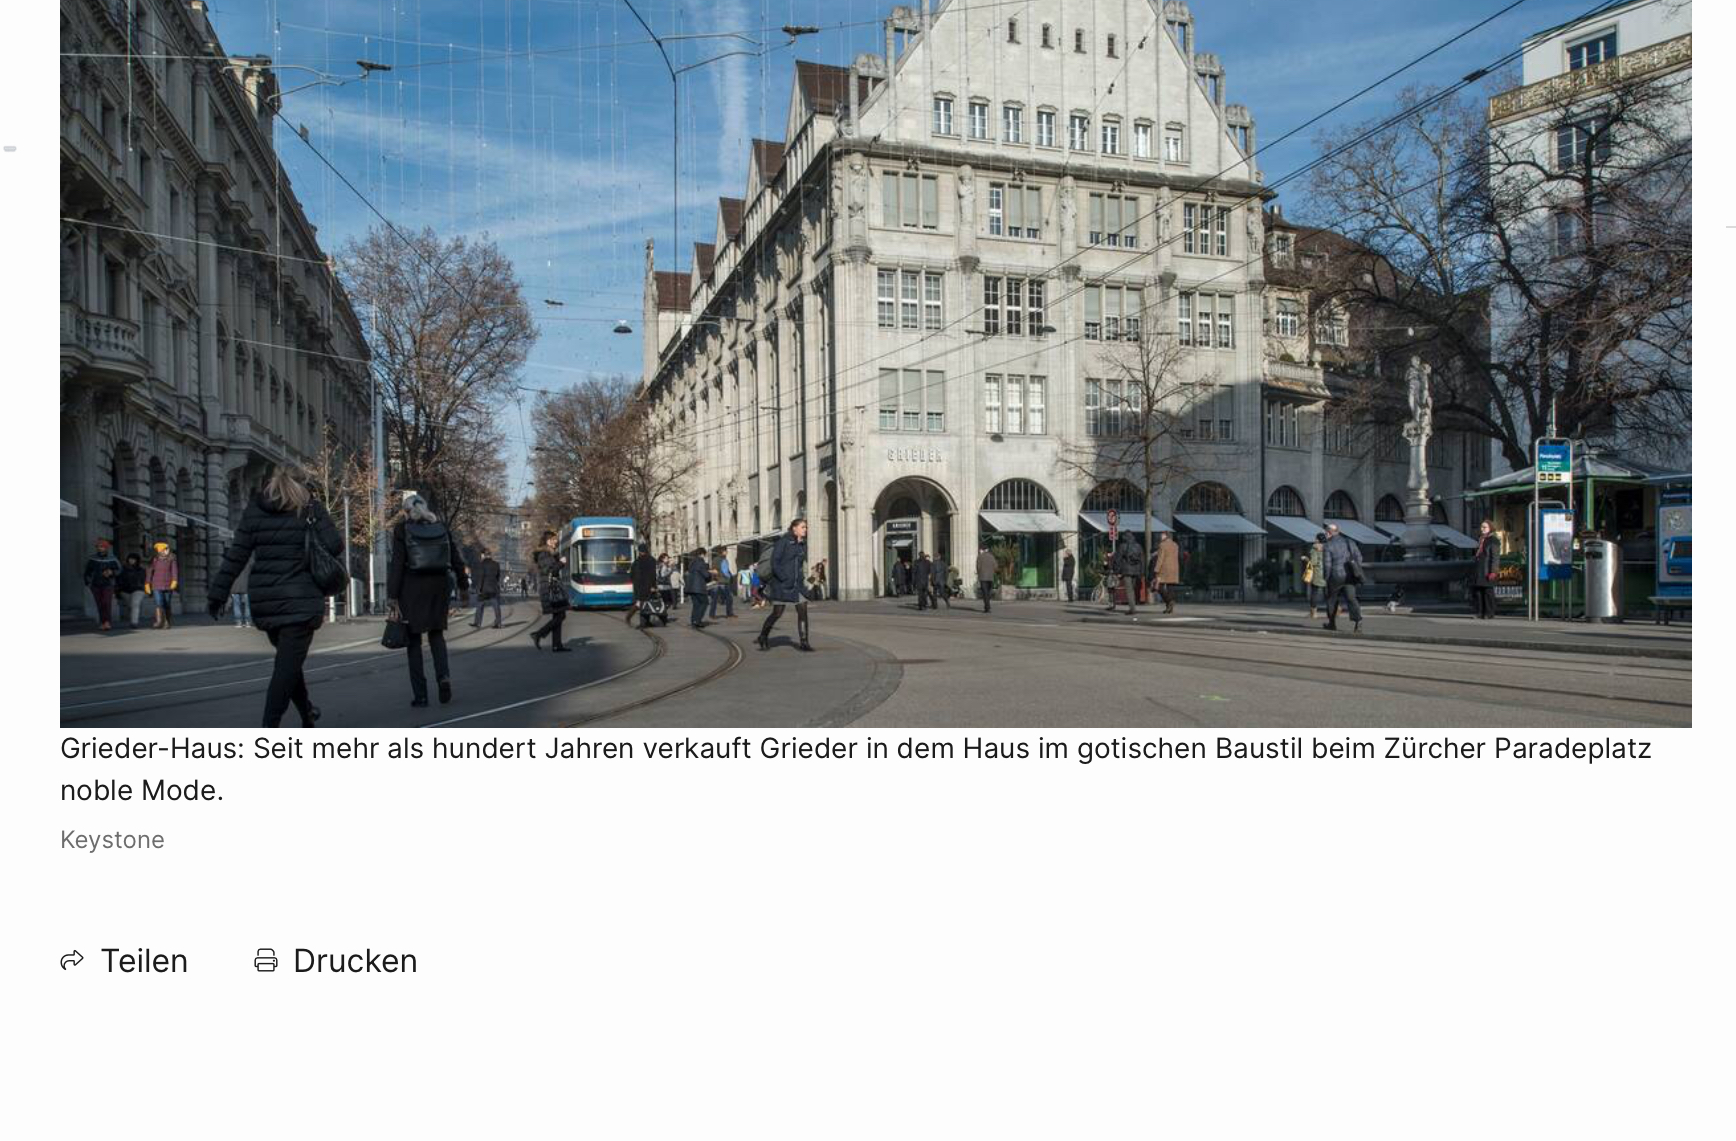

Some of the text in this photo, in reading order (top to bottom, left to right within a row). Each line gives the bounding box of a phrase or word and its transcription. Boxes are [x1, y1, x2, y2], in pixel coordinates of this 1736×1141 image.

[62, 737, 1651, 764] Grieder-Haus: Seit mehr als hundert Jahren verkauft Grieder in dem Haus im gotischen Baustil beim Zürcher Paradeplatz
[62, 779, 222, 801] noble Mode.
[62, 830, 164, 853] Keystone
[101, 948, 186, 973] Teilen
[296, 949, 416, 973] Drucken
